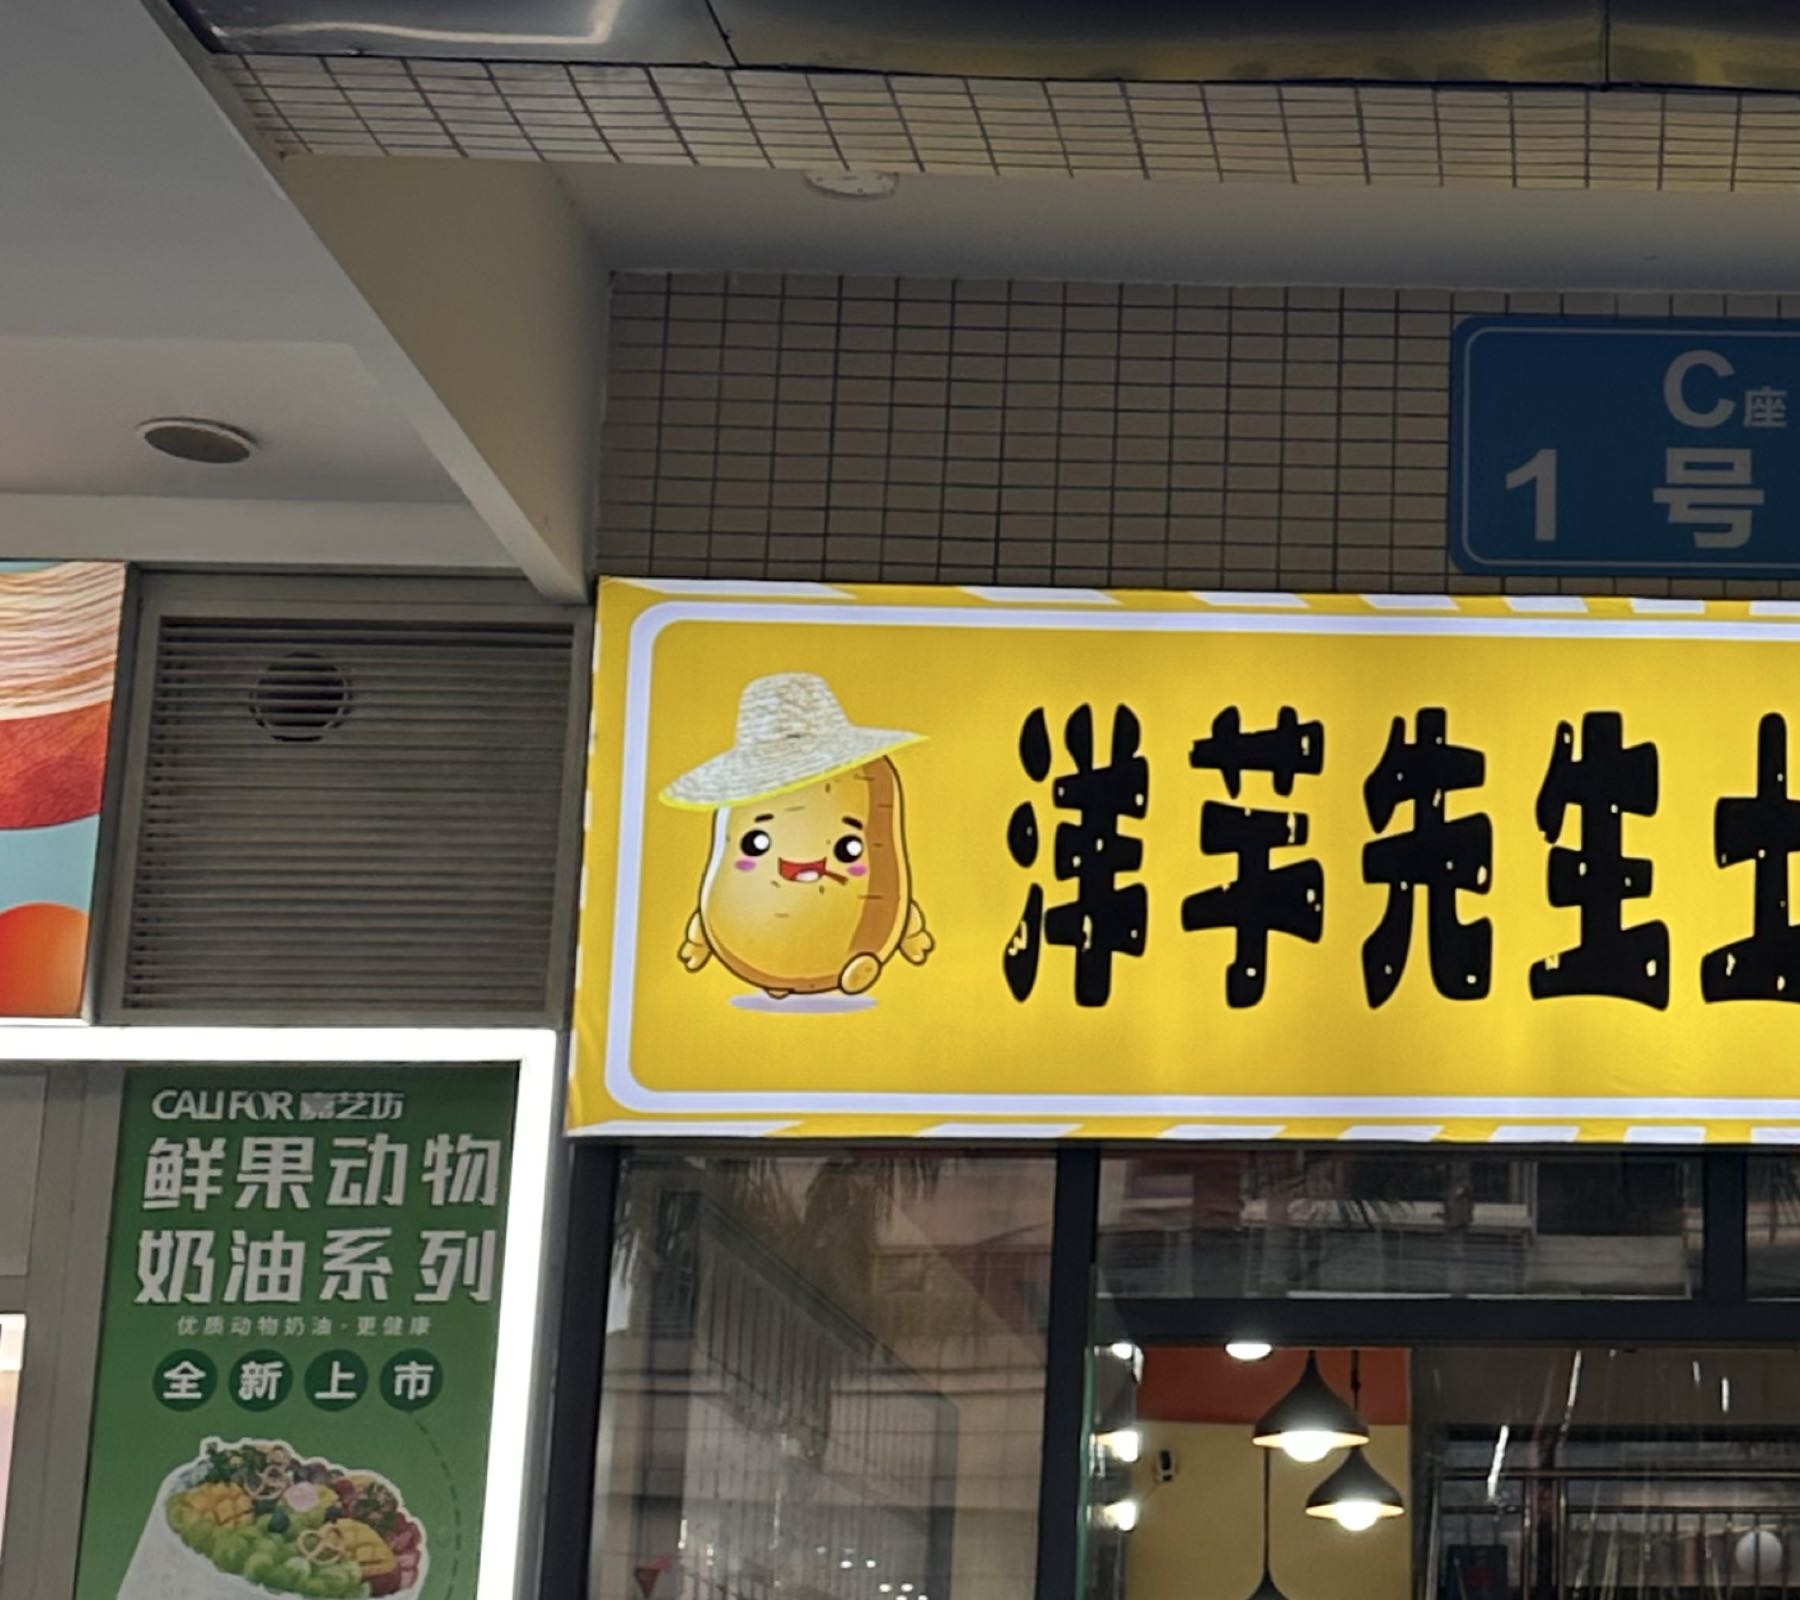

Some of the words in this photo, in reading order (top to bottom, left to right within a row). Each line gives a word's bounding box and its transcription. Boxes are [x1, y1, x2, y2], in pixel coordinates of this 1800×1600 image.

[1662, 348, 1788, 430] C座
[152, 1089, 295, 1121] CALIFOR
[142, 1132, 502, 1211] 鲜果动物
[133, 1227, 497, 1304] 奶油系列
[162, 1360, 435, 1401] 全新上市
